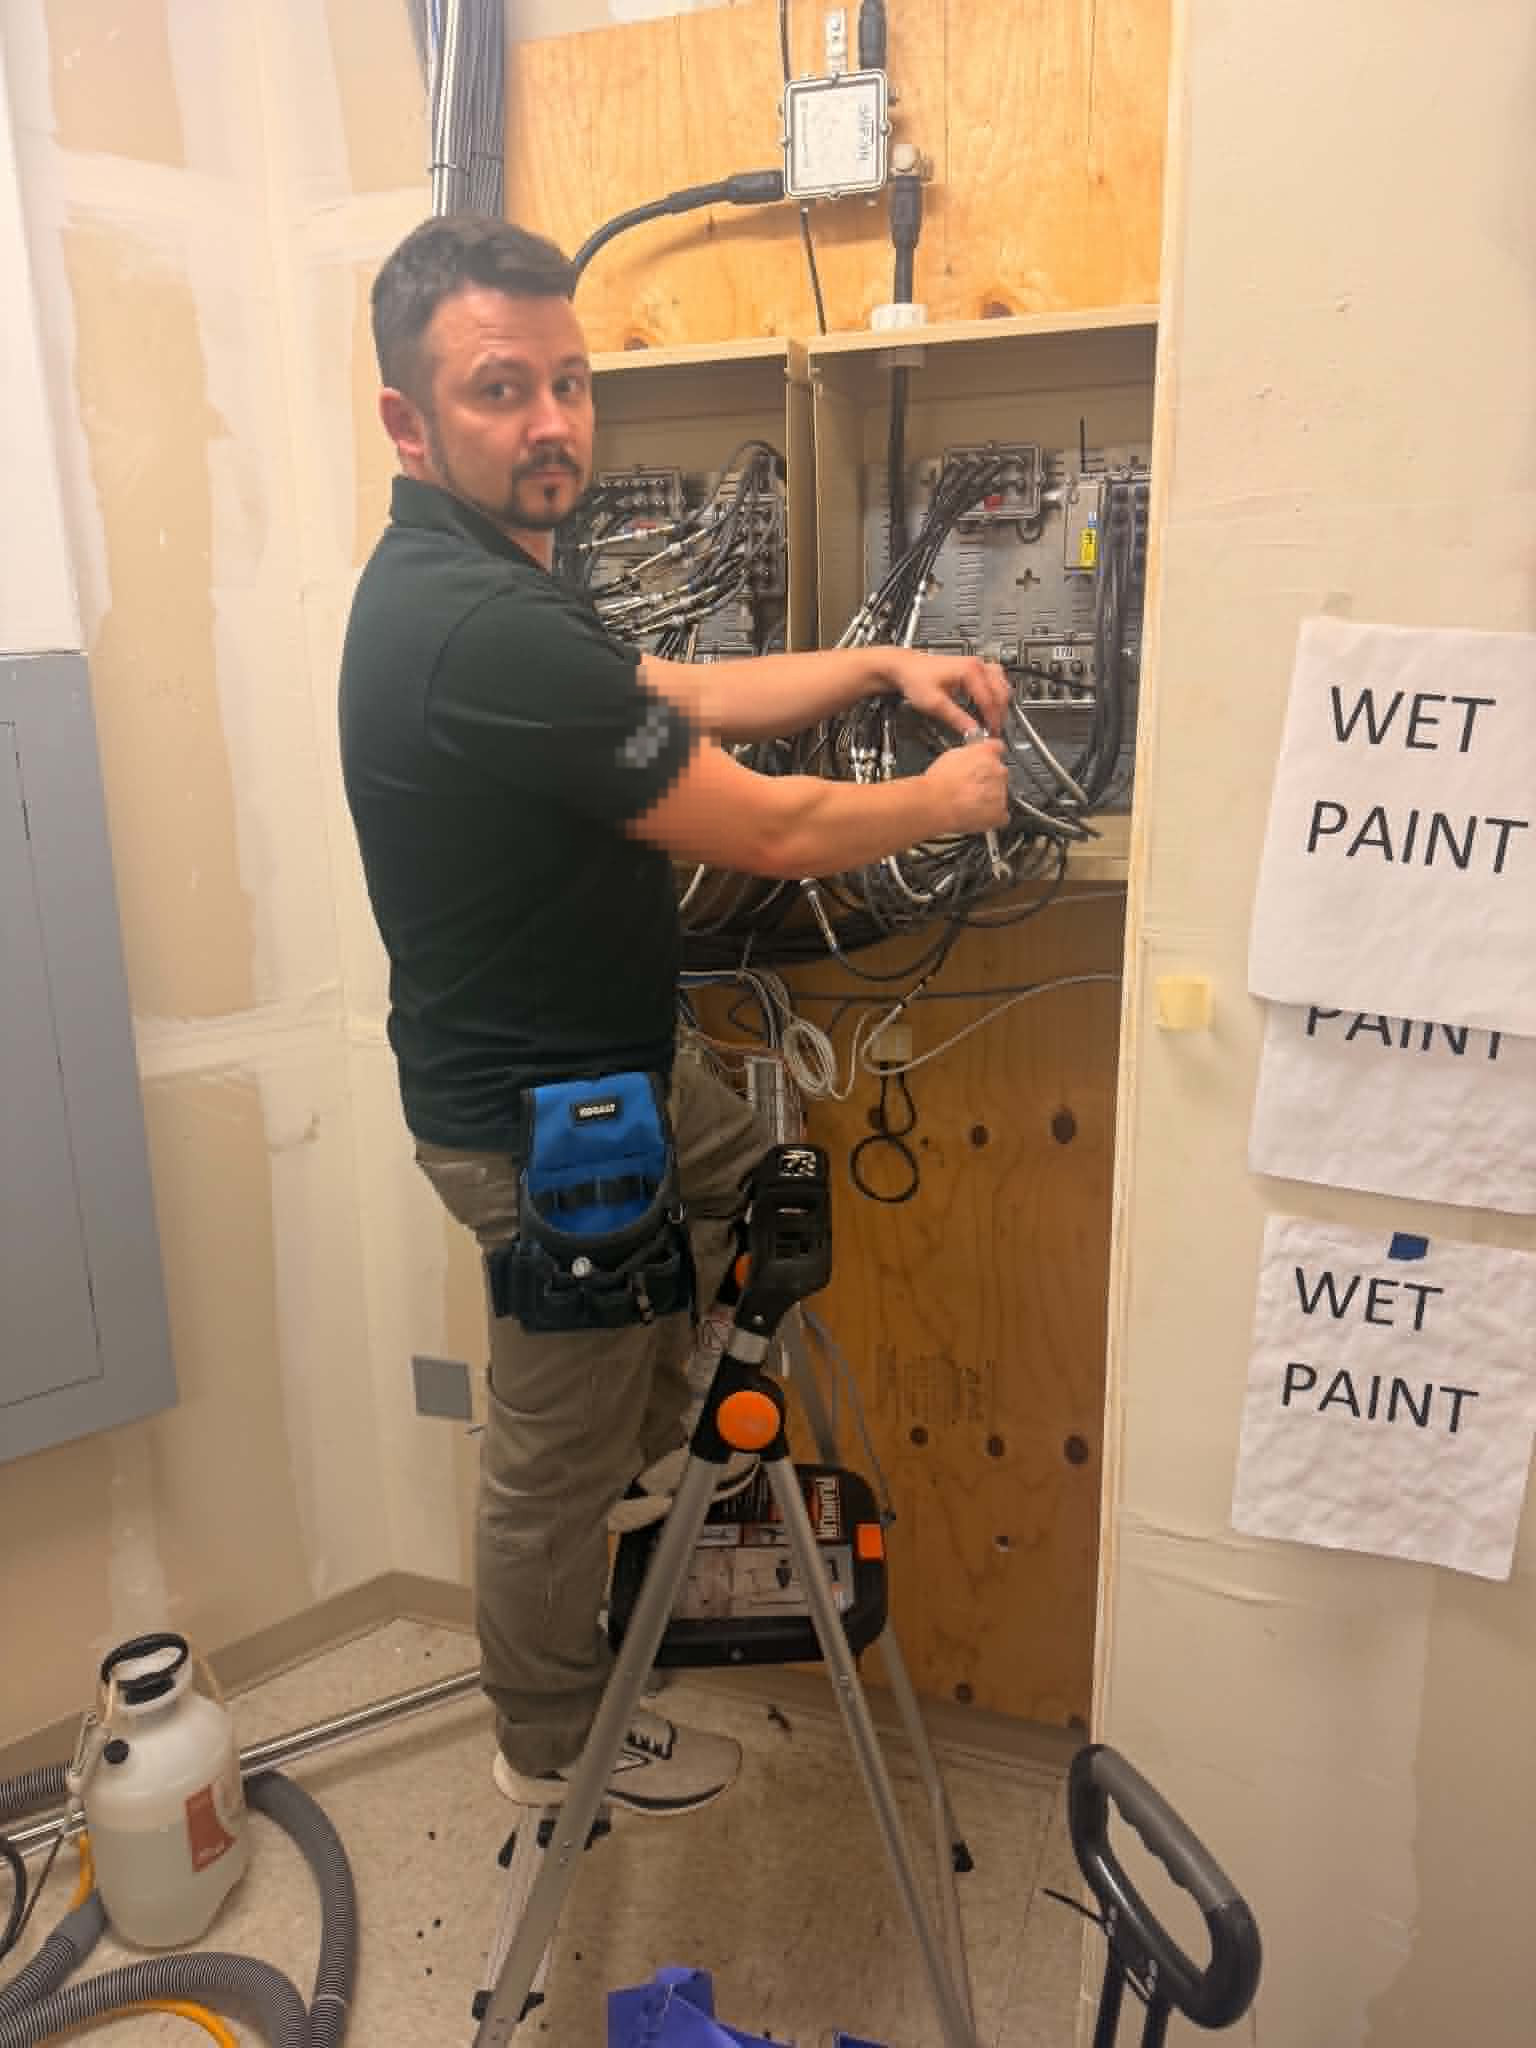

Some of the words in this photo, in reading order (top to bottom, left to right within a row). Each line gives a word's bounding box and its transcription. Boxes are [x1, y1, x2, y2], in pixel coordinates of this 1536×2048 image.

[1331, 685, 1497, 753] WET
[1307, 800, 1529, 874] PAINT
[1295, 1266, 1445, 1331] WET
[1282, 1362, 1480, 1433] PAINT
